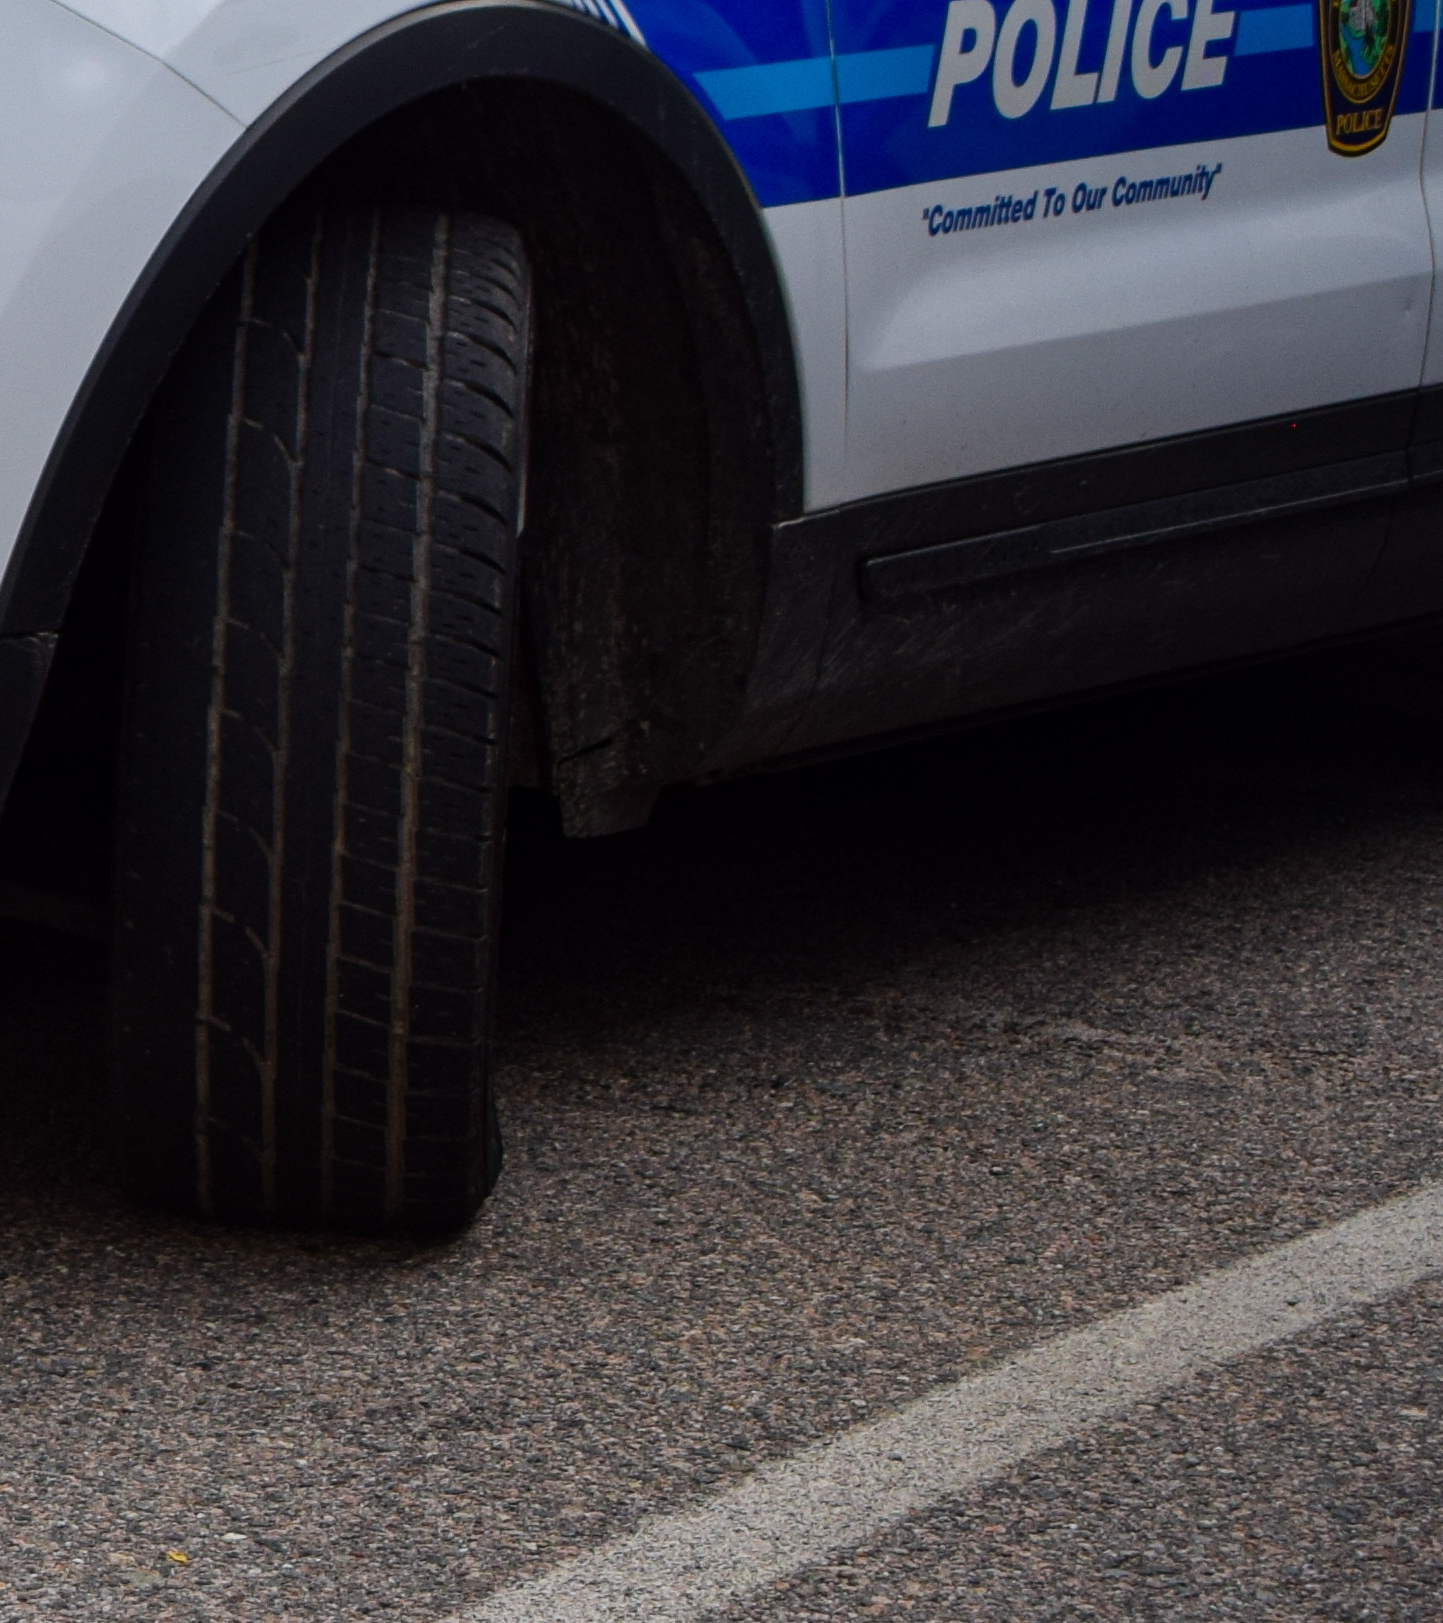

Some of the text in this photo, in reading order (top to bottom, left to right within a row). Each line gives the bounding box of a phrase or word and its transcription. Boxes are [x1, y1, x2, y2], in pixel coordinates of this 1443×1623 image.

[1336, 108, 1383, 135] POLICE
[1043, 187, 1066, 218] To
[1072, 182, 1108, 214] Our
